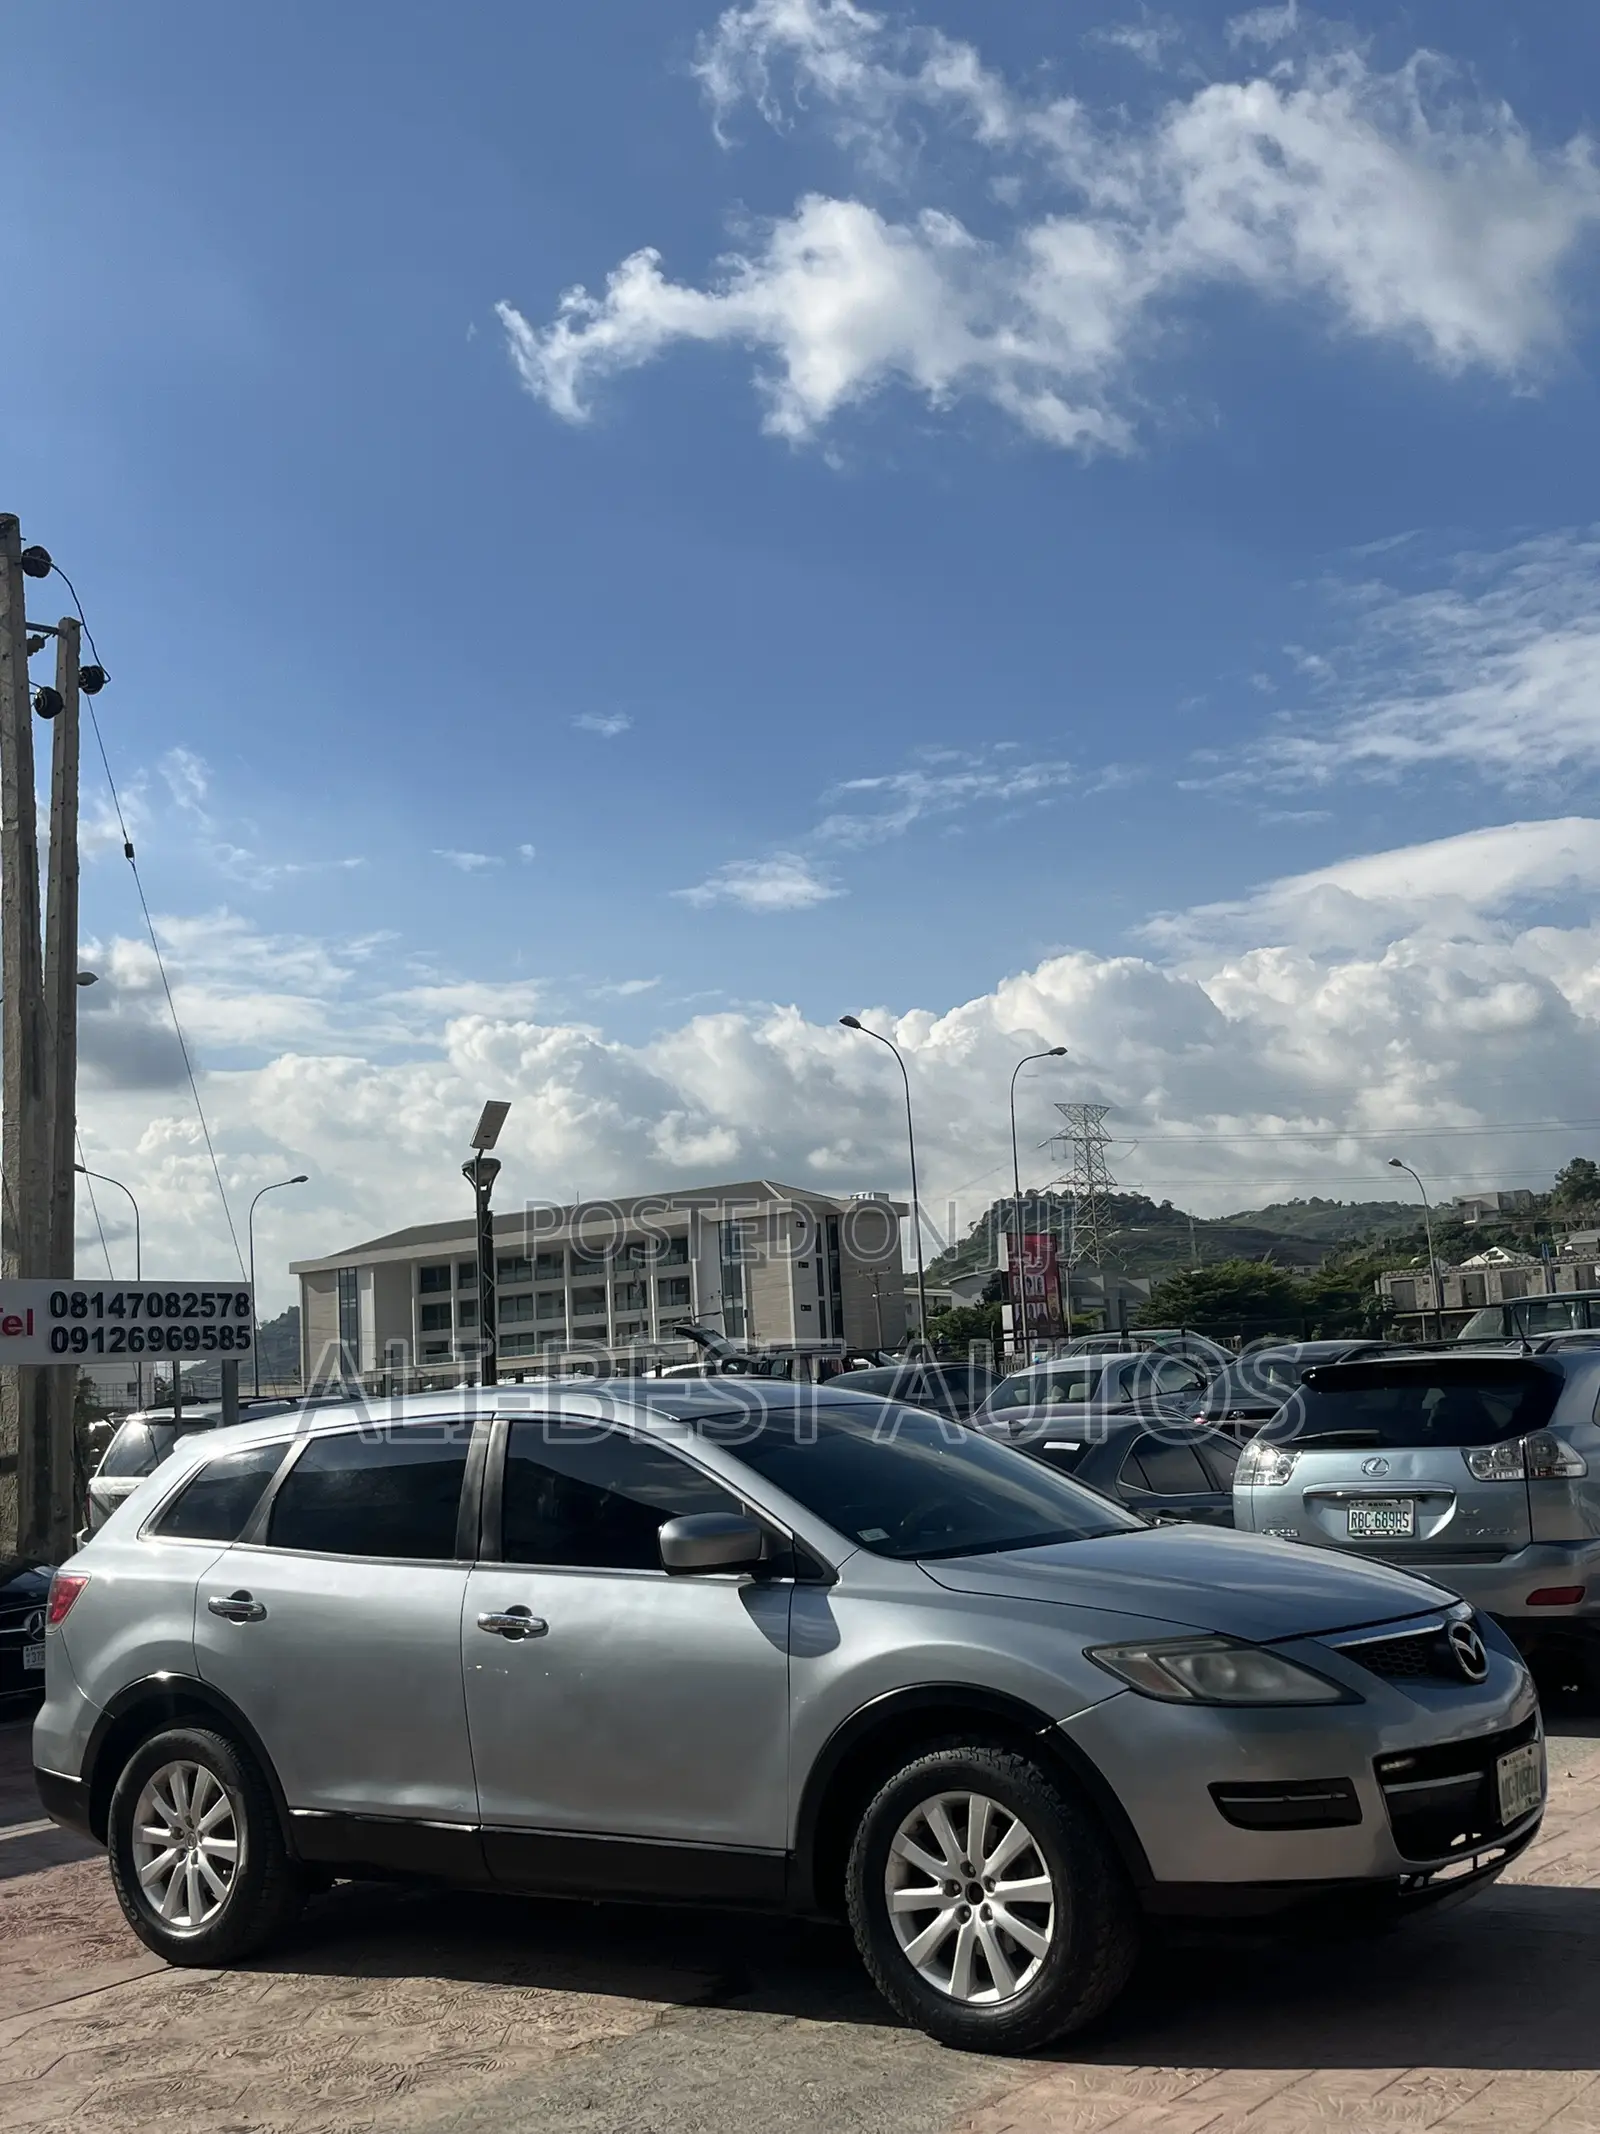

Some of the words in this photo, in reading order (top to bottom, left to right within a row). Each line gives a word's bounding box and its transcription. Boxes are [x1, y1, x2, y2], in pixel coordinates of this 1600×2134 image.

[50, 1291, 249, 1318] 08147082578
[0, 1307, 33, 1336] el
[51, 1325, 250, 1353] 09126969585
